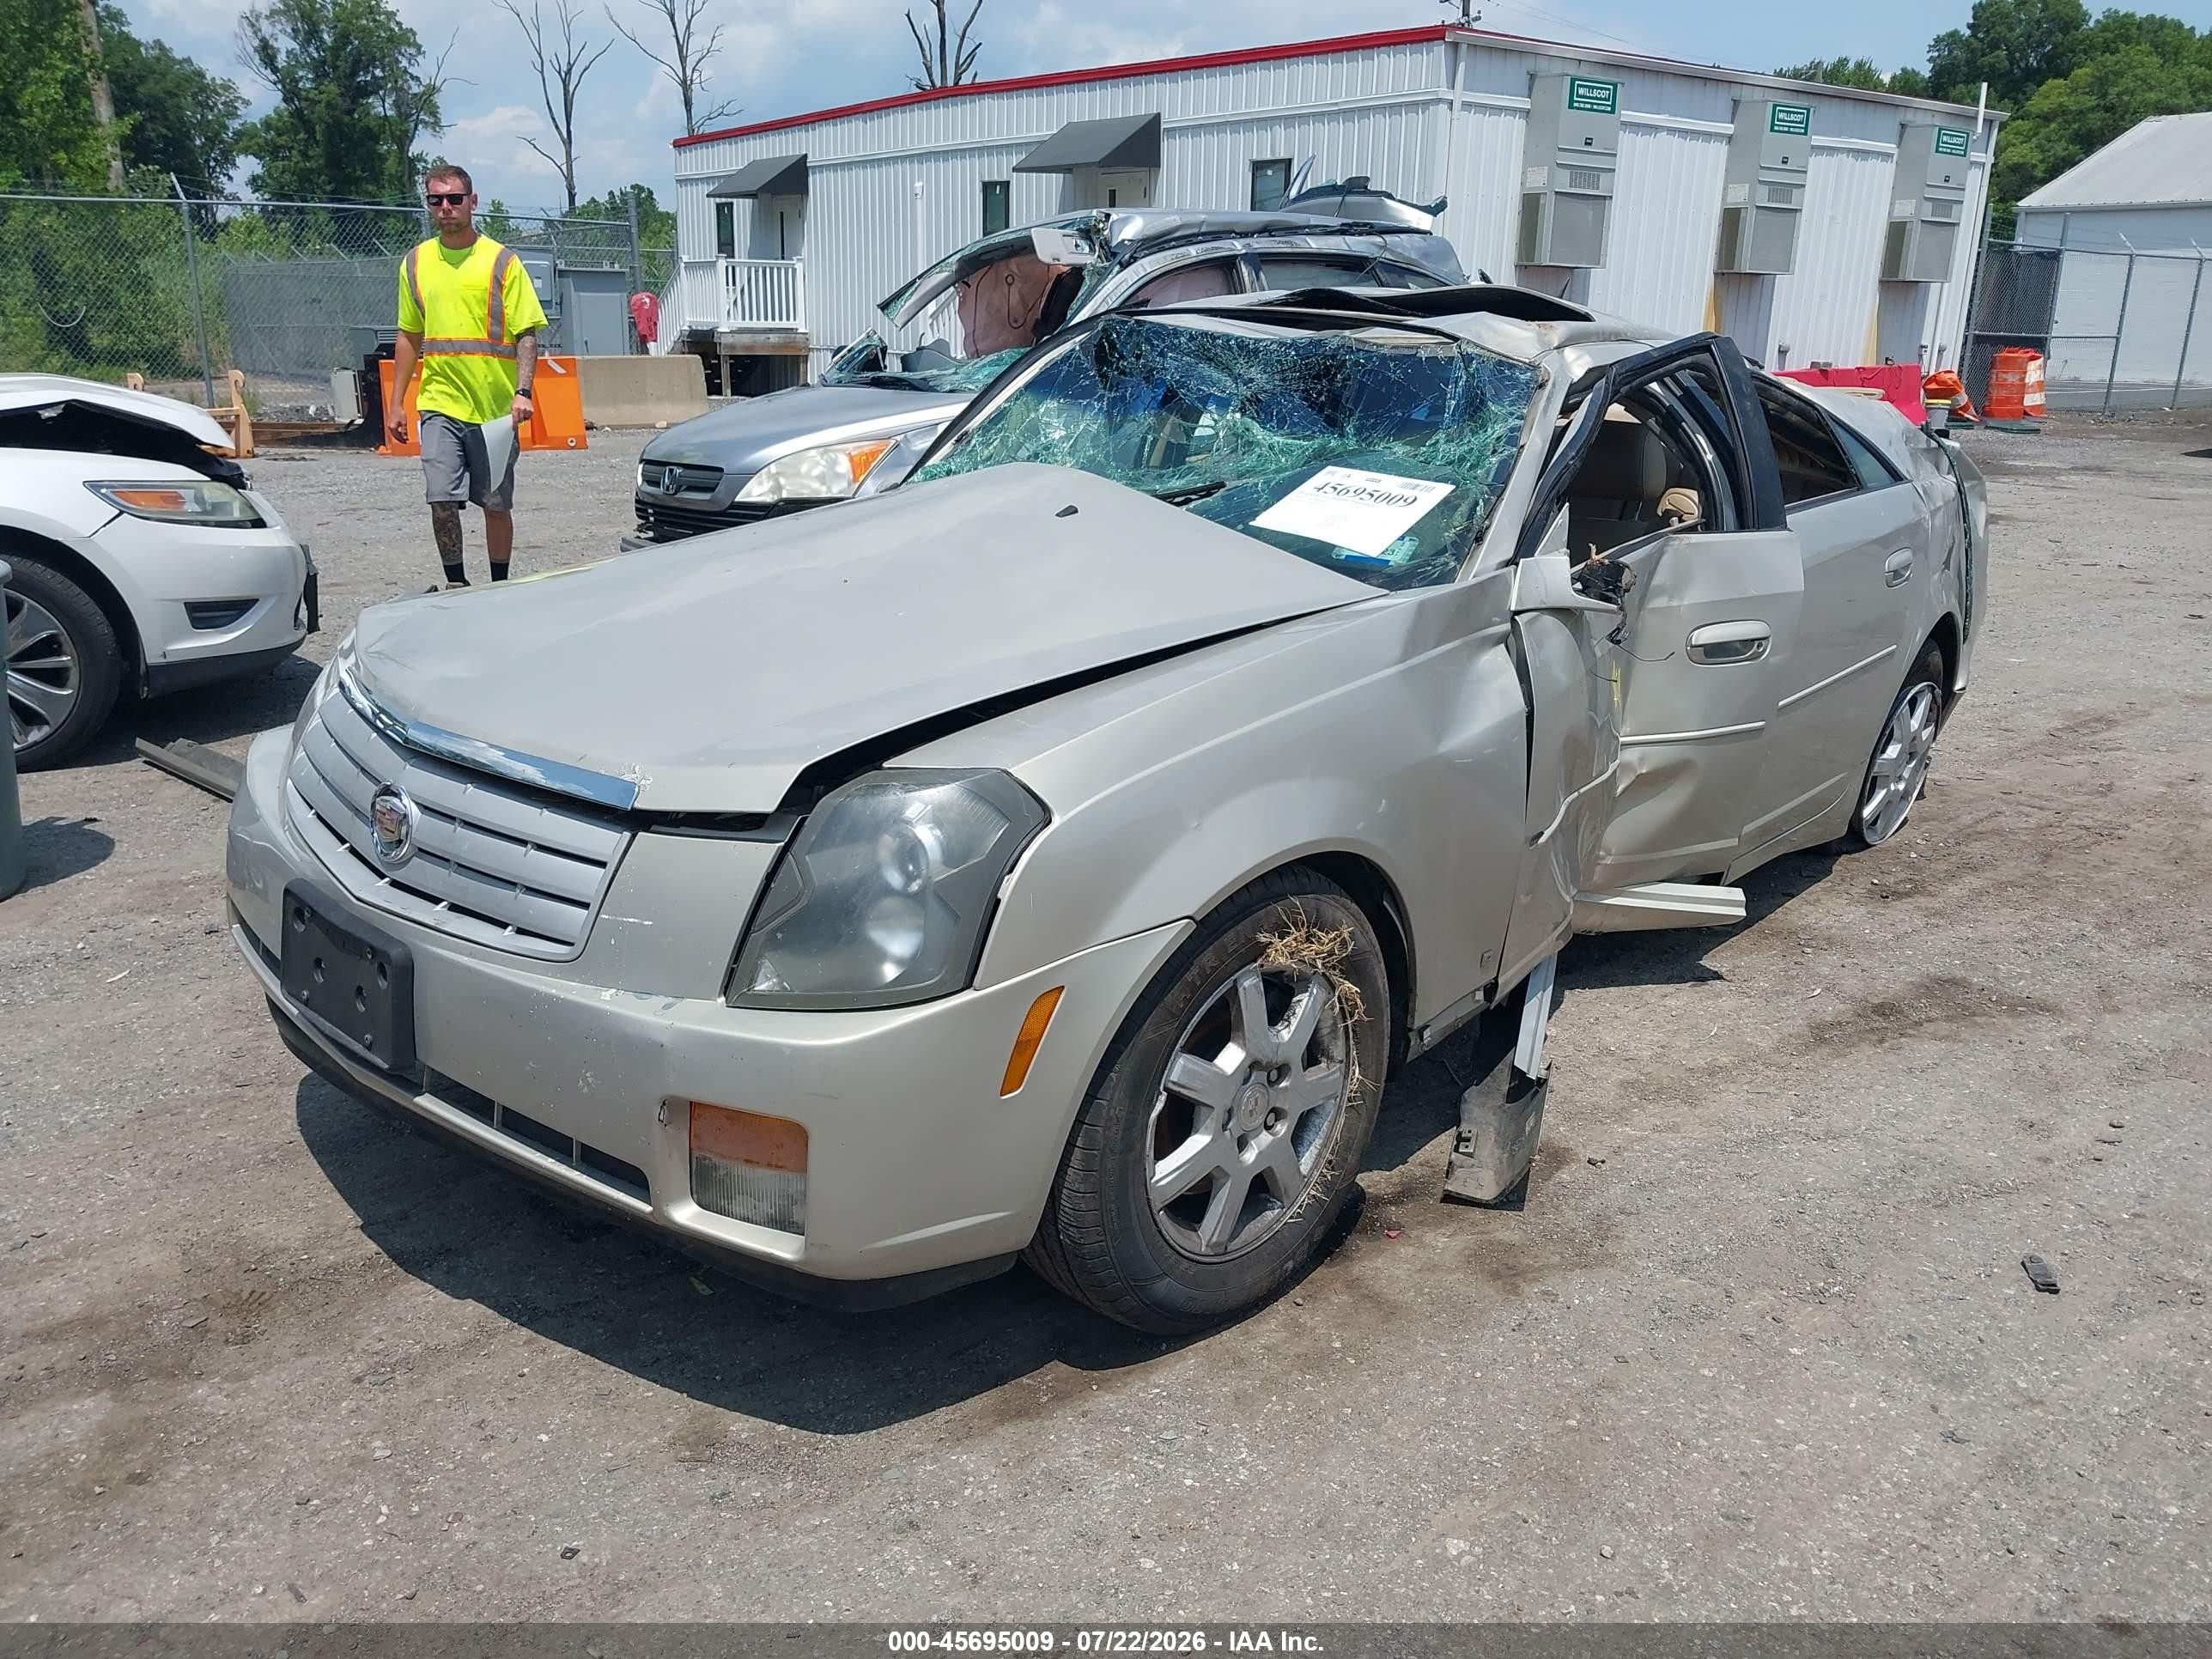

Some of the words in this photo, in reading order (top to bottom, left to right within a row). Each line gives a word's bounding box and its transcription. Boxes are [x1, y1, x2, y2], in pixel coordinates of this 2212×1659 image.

[1577, 87, 1610, 99] WILLSCOT
[1778, 112, 1804, 123] WILLSCOT
[1942, 135, 1965, 144] WILLSCOT
[1313, 482, 1418, 507] 45695009
